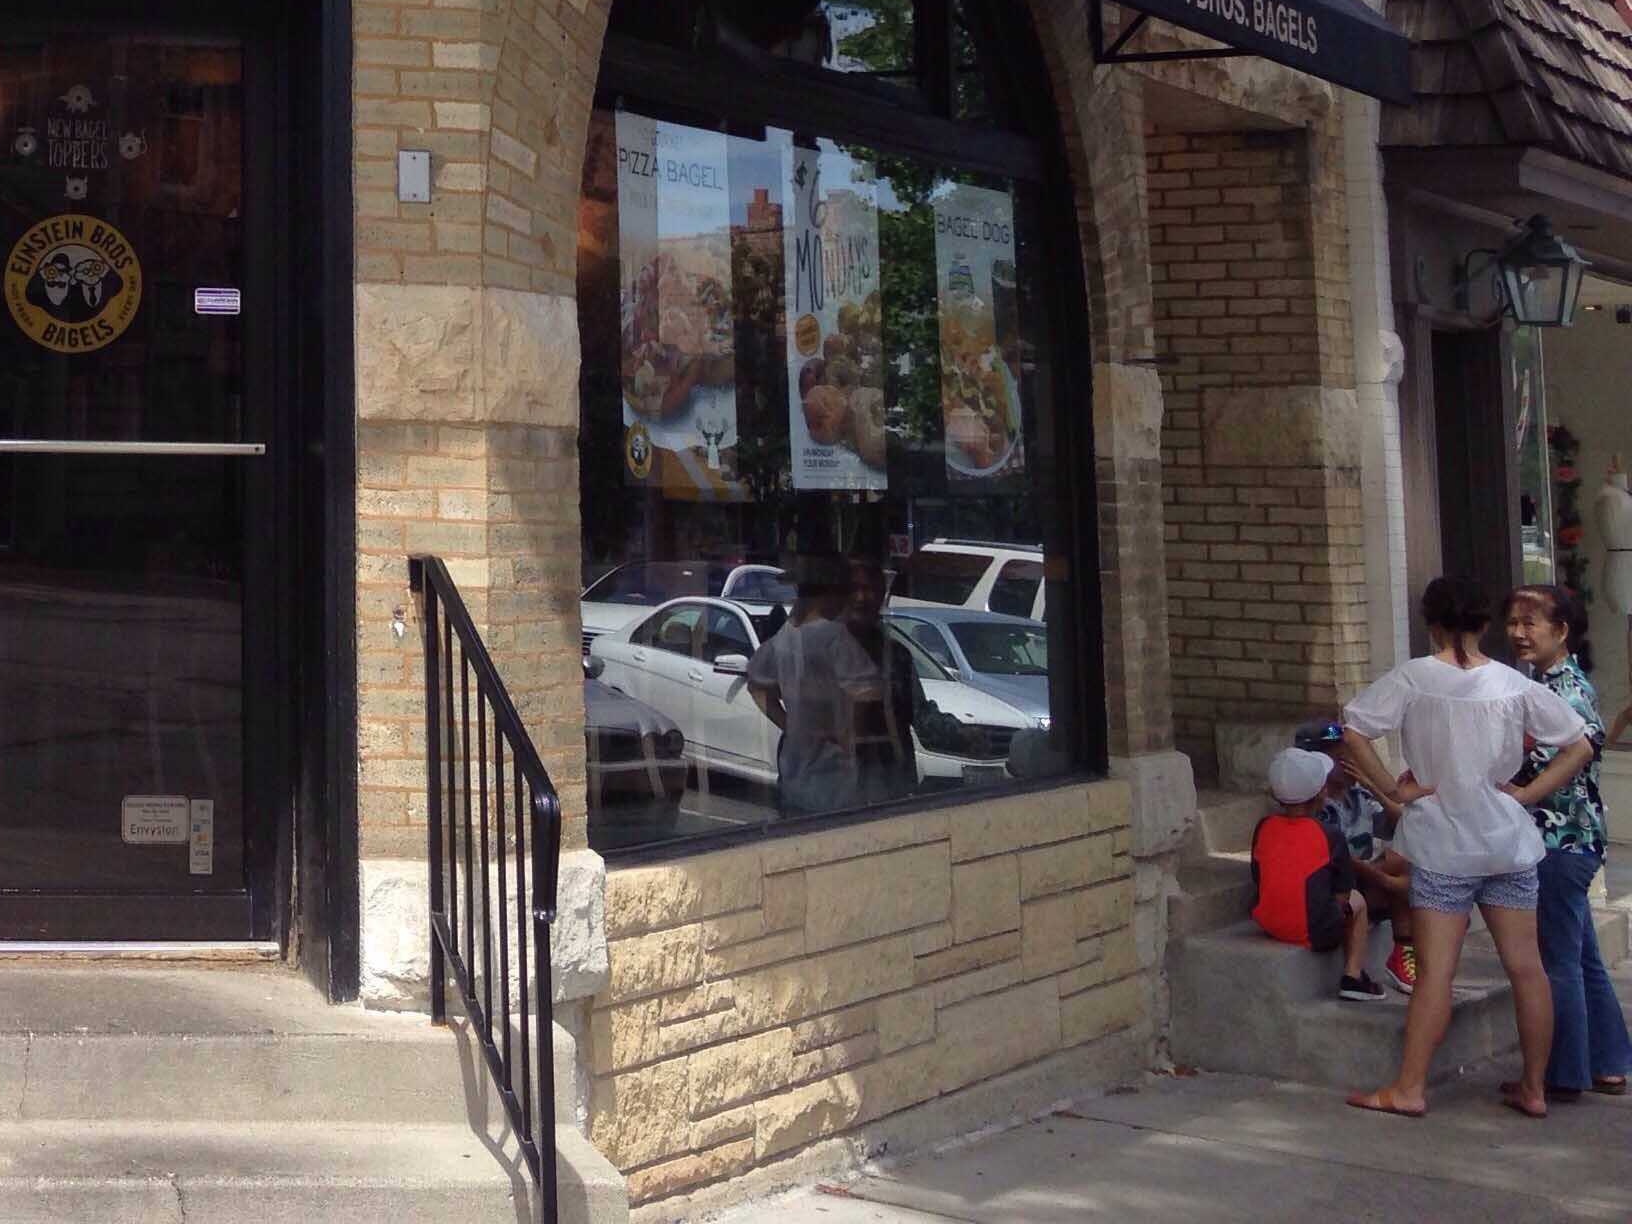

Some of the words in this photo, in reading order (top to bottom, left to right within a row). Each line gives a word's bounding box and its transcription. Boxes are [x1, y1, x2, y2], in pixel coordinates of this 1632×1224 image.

[47, 139, 109, 169] TOPPERS
[618, 147, 662, 179] PIZZA
[666, 159, 724, 191] BAGEL
[936, 214, 978, 240] BAGEL
[983, 221, 1010, 245] DOG
[10, 220, 84, 276] EINSTEIN
[90, 224, 133, 269] BROS
[41, 318, 115, 347] BAGELS
